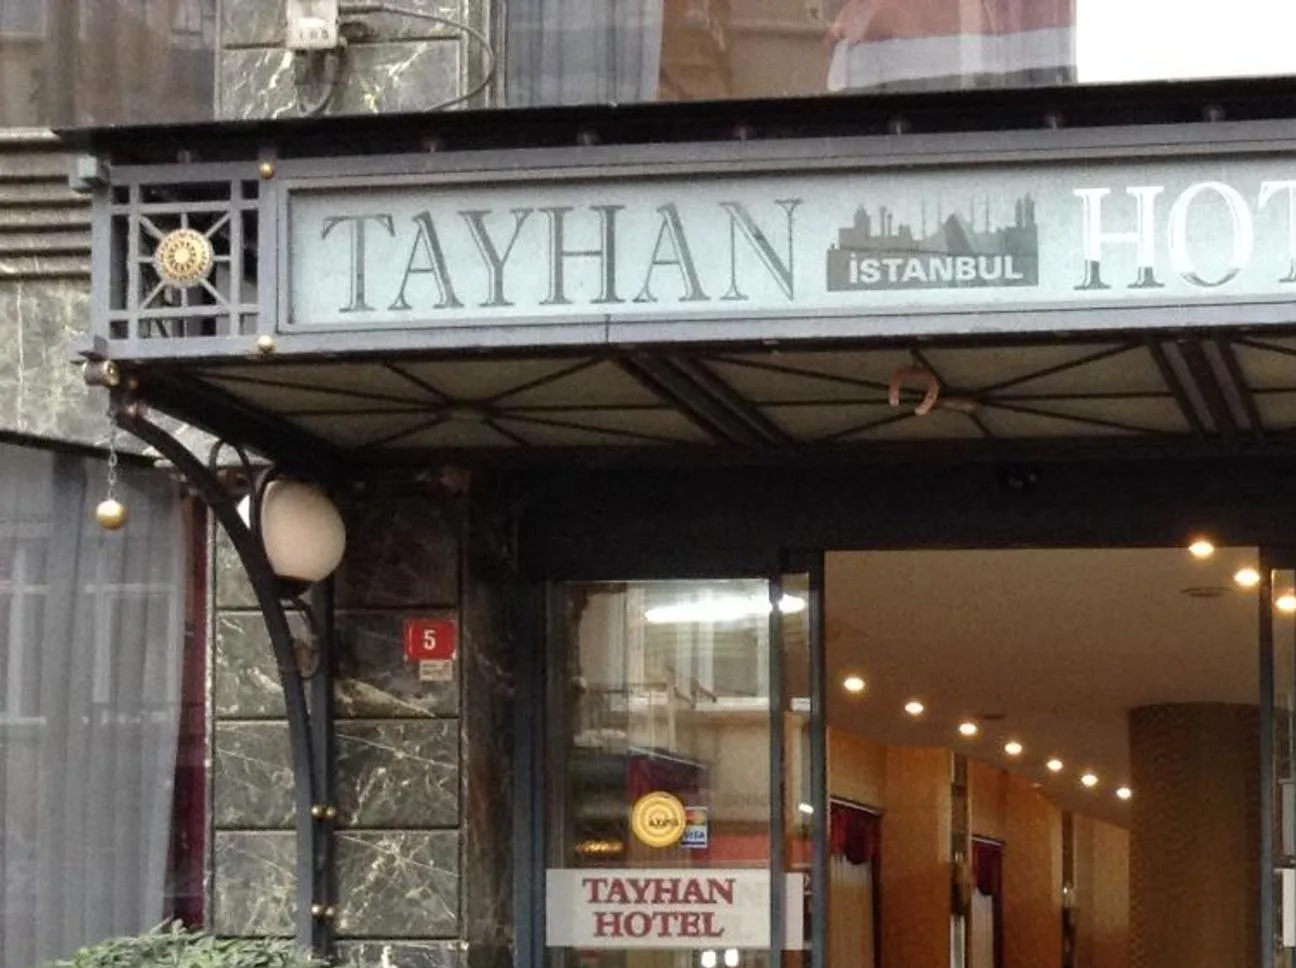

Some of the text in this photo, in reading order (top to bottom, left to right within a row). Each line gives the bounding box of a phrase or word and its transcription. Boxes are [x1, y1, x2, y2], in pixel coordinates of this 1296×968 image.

[320, 199, 802, 312] TAYHAN
[849, 253, 1023, 285] İSTANBUL
[423, 628, 437, 650] 5
[582, 878, 736, 905] TAYHAN
[593, 911, 724, 938] HOTEL
